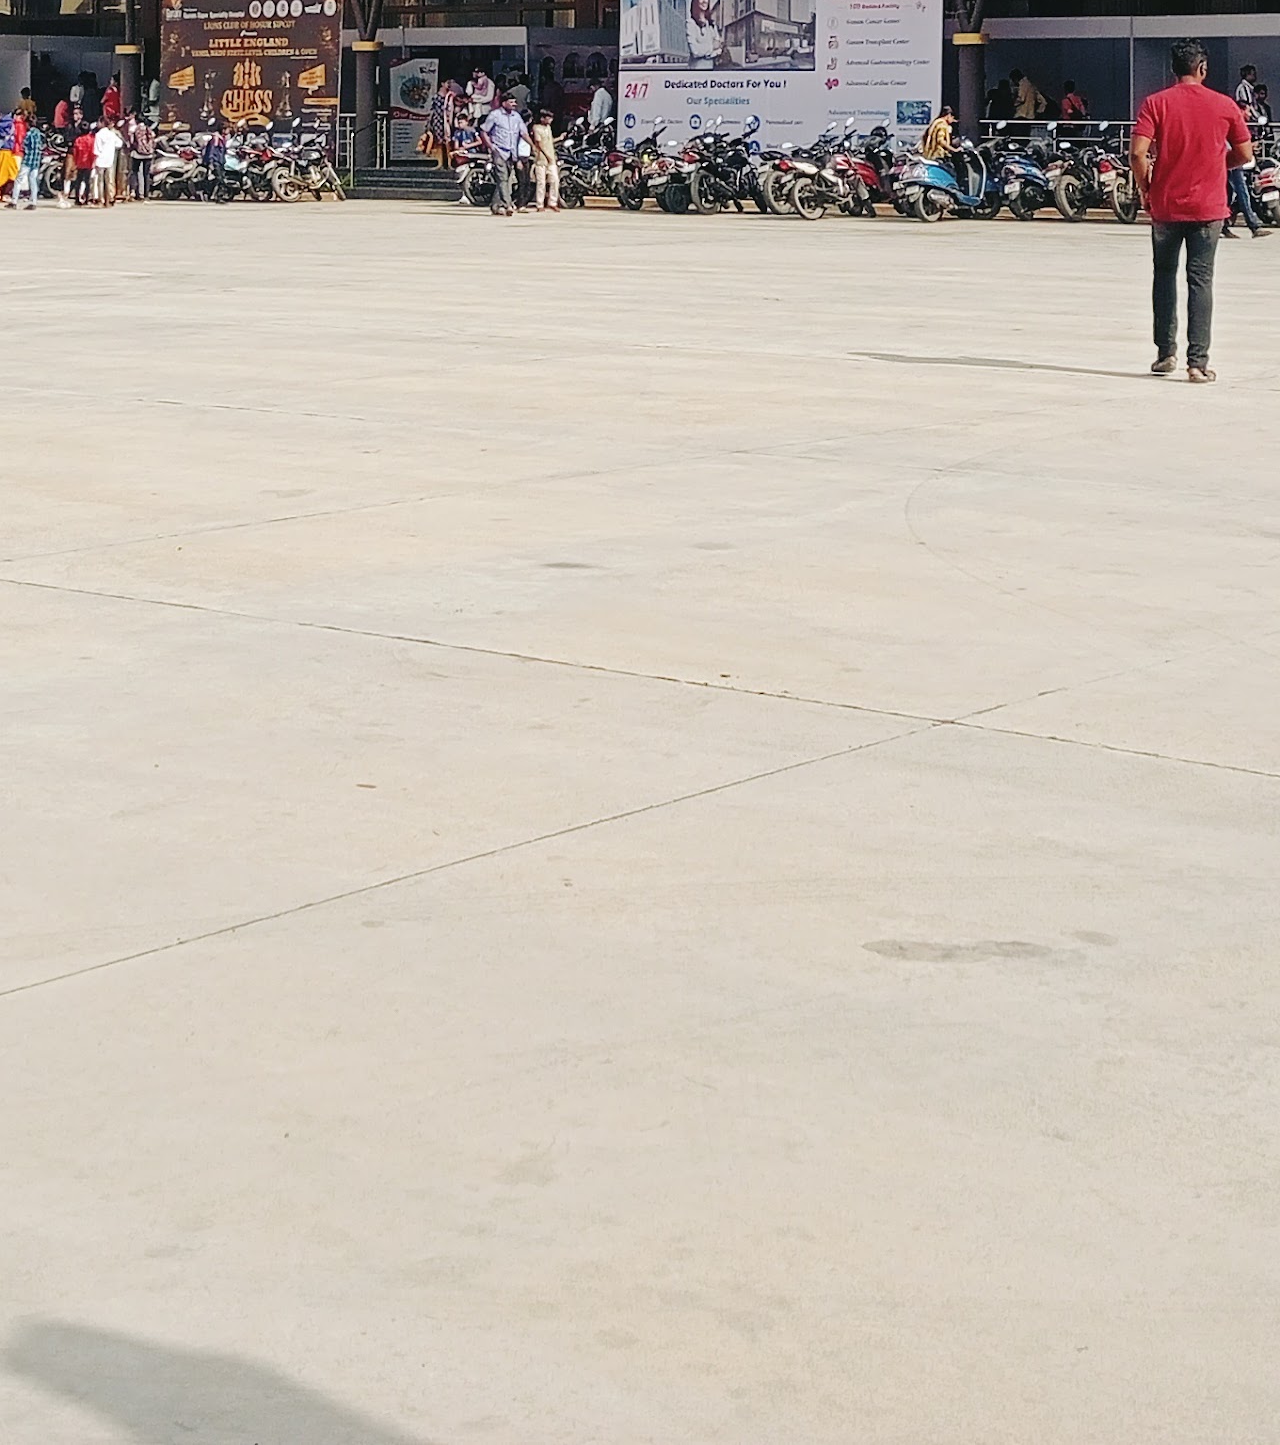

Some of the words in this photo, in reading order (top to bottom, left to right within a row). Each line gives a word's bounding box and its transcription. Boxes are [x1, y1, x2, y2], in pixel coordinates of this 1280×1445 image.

[209, 38, 242, 48] LITTLE
[243, 37, 288, 47] ENGLAND
[624, 82, 649, 99] 24/7
[664, 79, 708, 89] Dedicated
[710, 79, 744, 89] Doctors
[746, 79, 761, 88] For
[764, 80, 782, 88] You
[221, 89, 273, 115] CHESS
[686, 96, 702, 105] Our
[703, 96, 750, 107] Specialities
